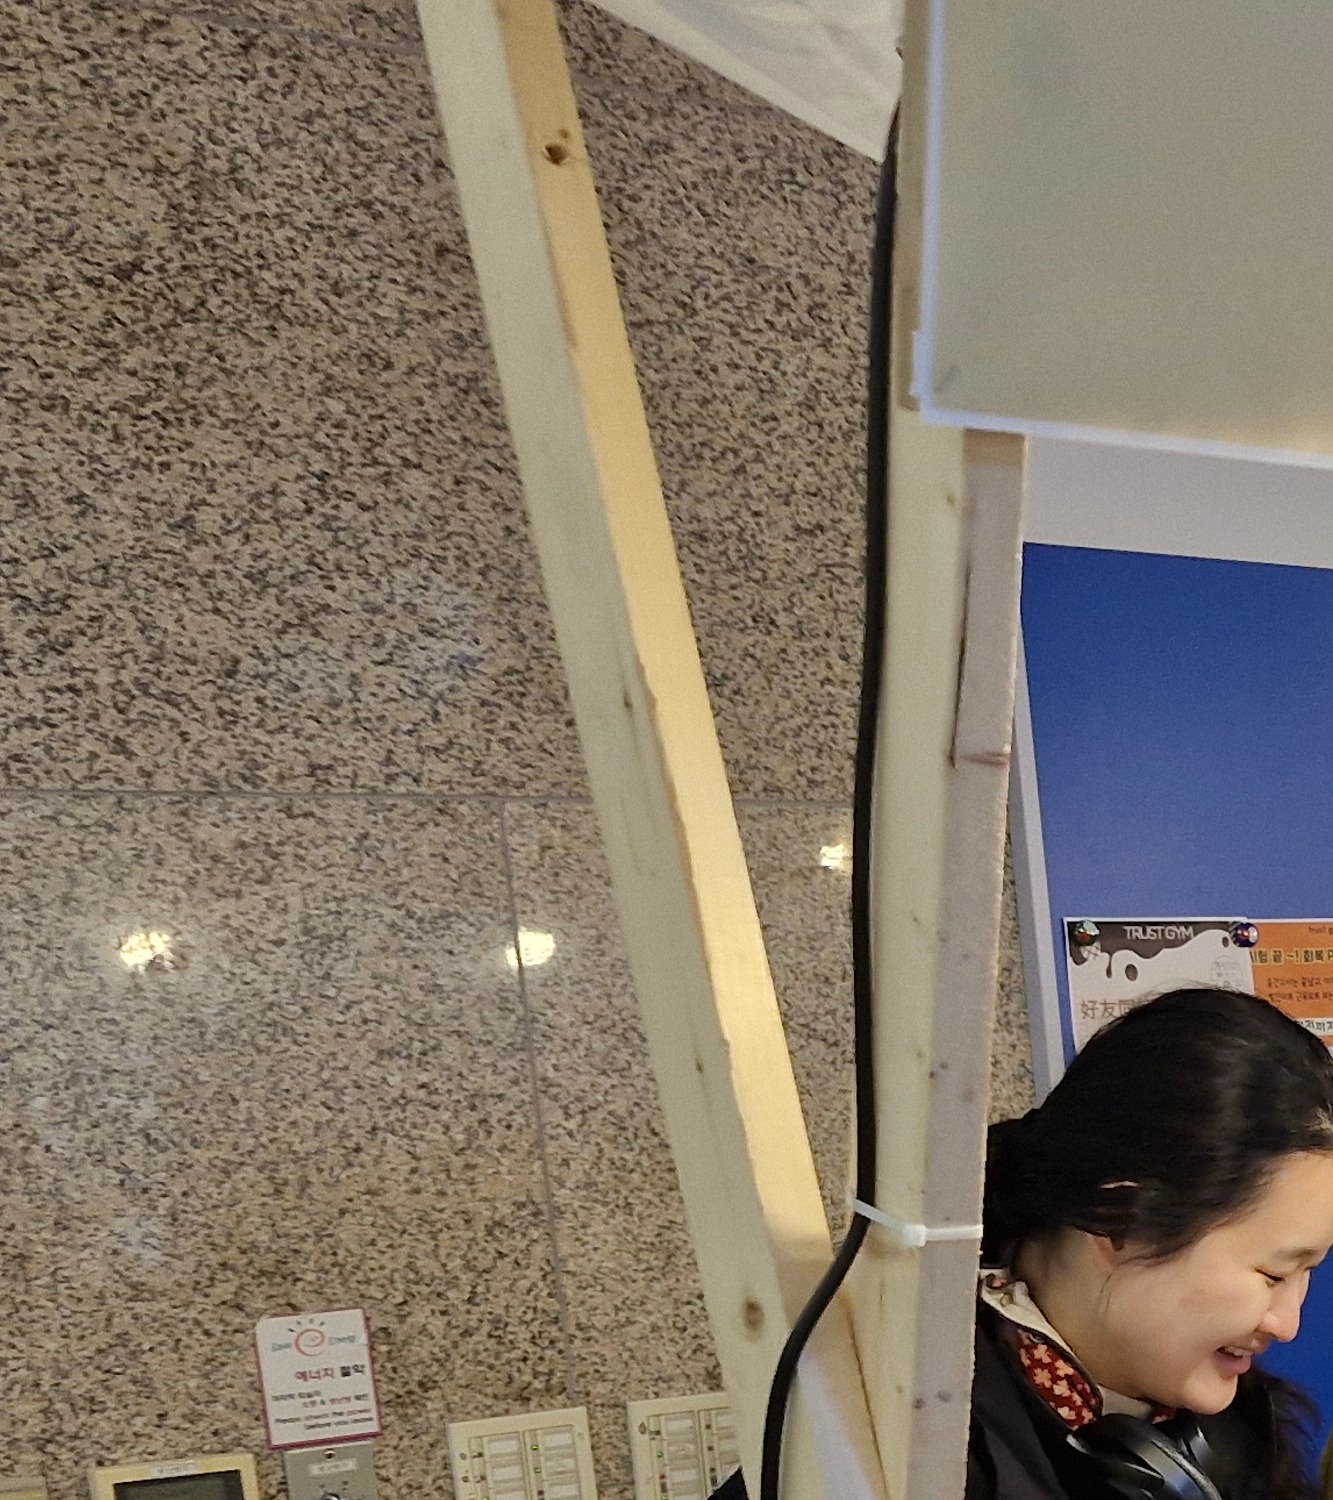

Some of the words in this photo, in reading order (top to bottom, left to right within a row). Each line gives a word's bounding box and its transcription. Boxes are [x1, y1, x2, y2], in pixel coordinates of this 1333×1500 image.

[1123, 925, 1165, 940] TRUST
[1165, 925, 1195, 941] GYM
[1272, 949, 1283, 964] 끝
[1303, 948, 1325, 963] 회복
[1081, 998, 1146, 1021] 好友同
[294, 1367, 335, 1383] 에너지
